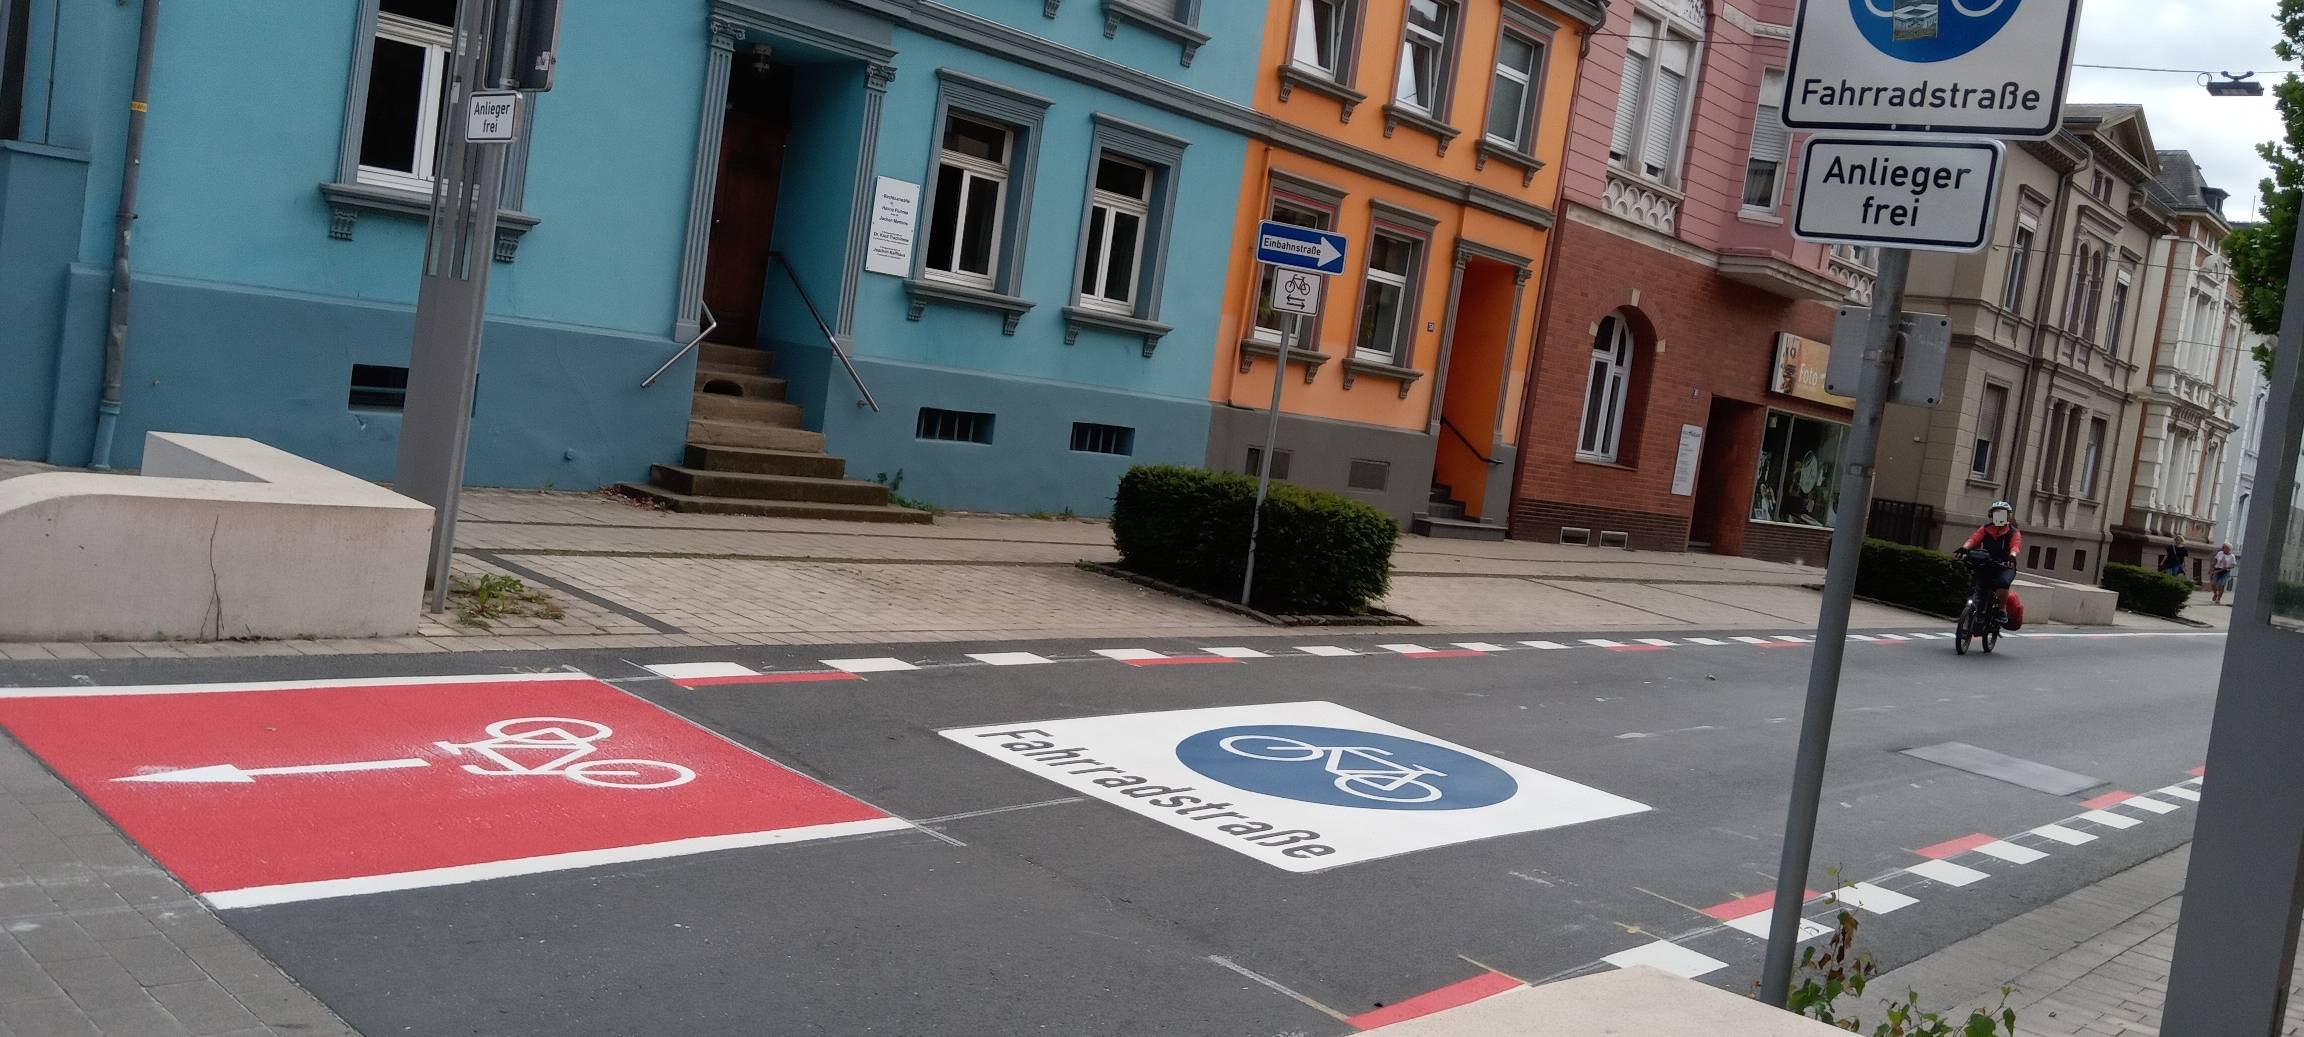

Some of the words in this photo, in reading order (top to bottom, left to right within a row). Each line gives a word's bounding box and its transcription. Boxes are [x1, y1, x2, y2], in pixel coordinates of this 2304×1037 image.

[474, 101, 510, 118] Anlieger
[1801, 78, 2041, 111] Fahrradstraße
[482, 119, 498, 133] frei
[1822, 155, 1972, 196] Anlieger
[1861, 196, 1920, 227] frei
[1263, 237, 1321, 256] Einbahnstraße
[975, 728, 1336, 859] Fahrradstraße
